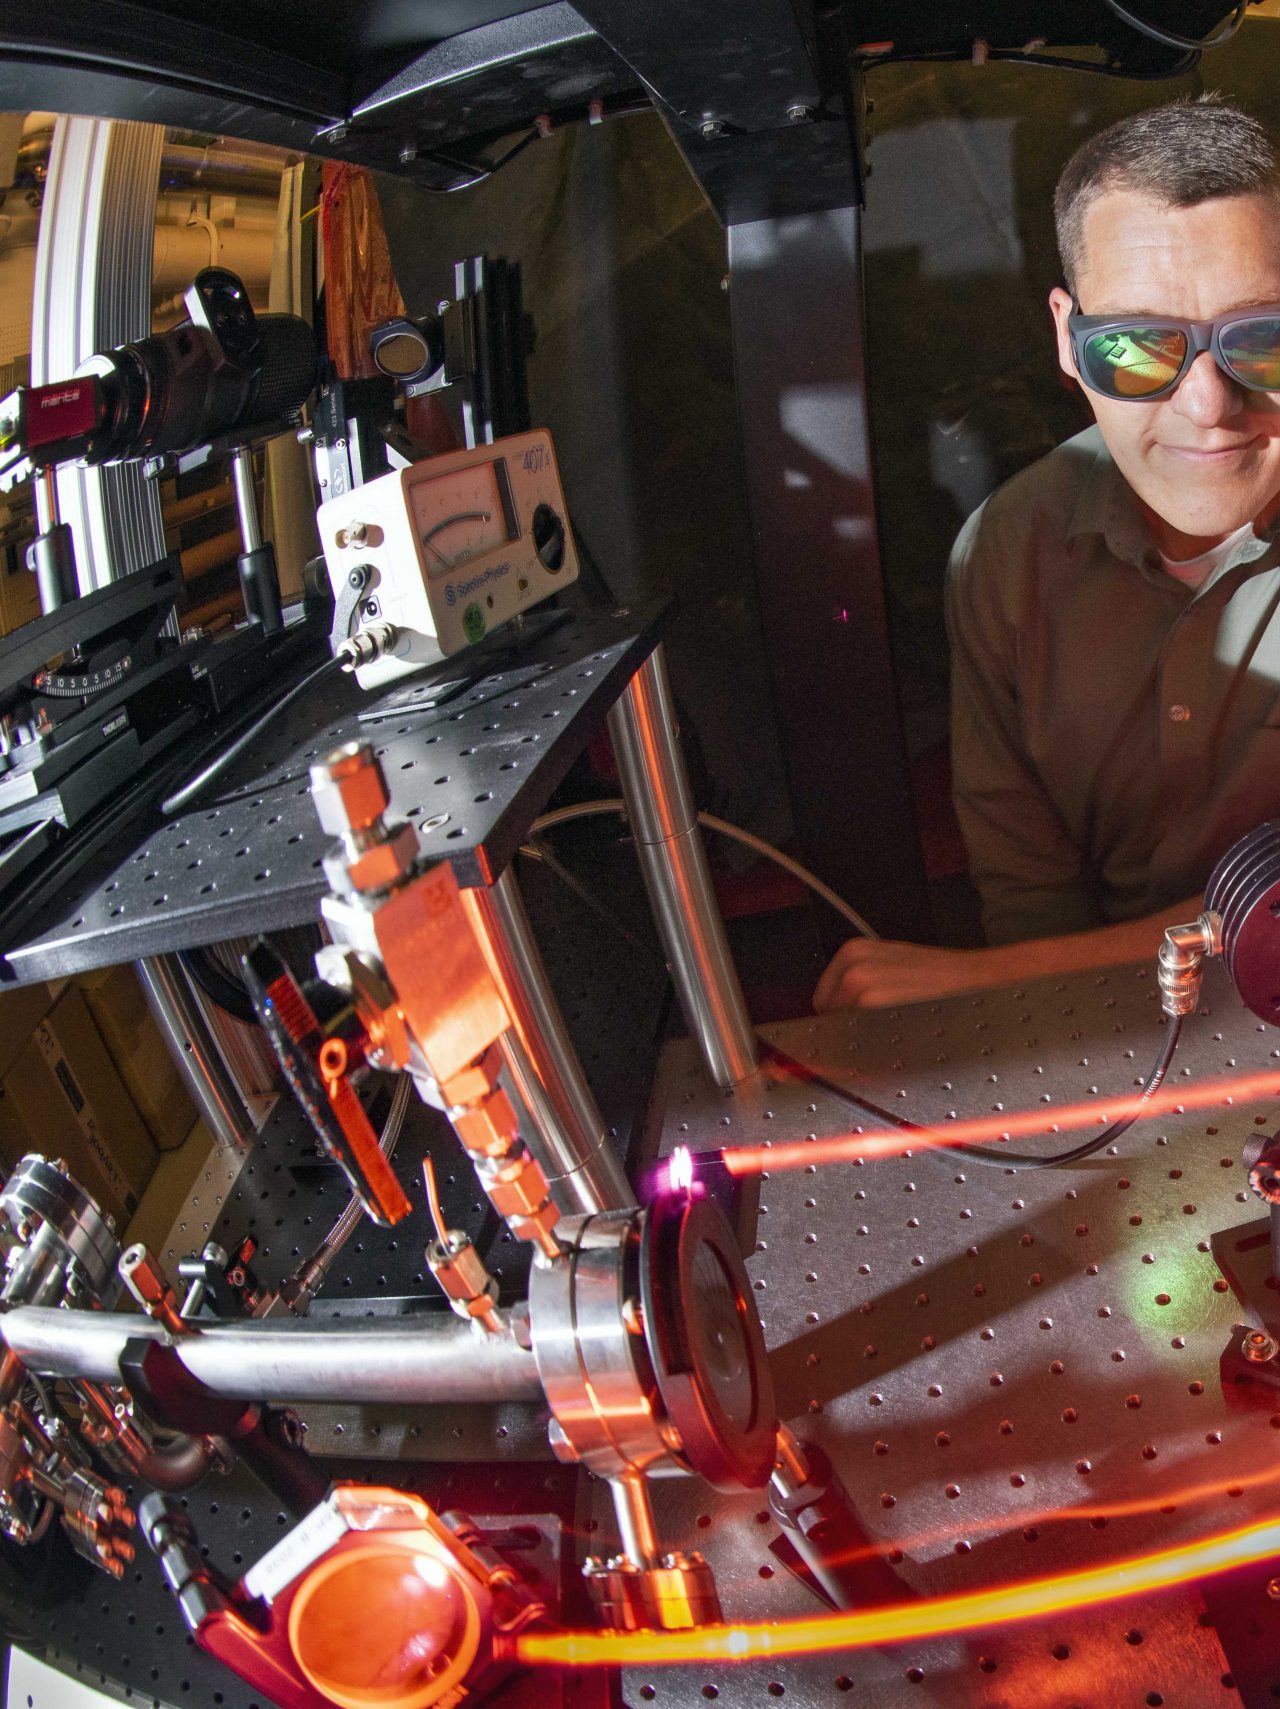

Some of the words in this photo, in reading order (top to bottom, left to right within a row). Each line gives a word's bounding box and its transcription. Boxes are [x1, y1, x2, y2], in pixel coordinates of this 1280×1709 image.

[57, 678, 65, 688] 10
[70, 679, 76, 688] 5
[82, 677, 88, 687] 0
[94, 674, 99, 684] 5
[104, 669, 111, 679] 10
